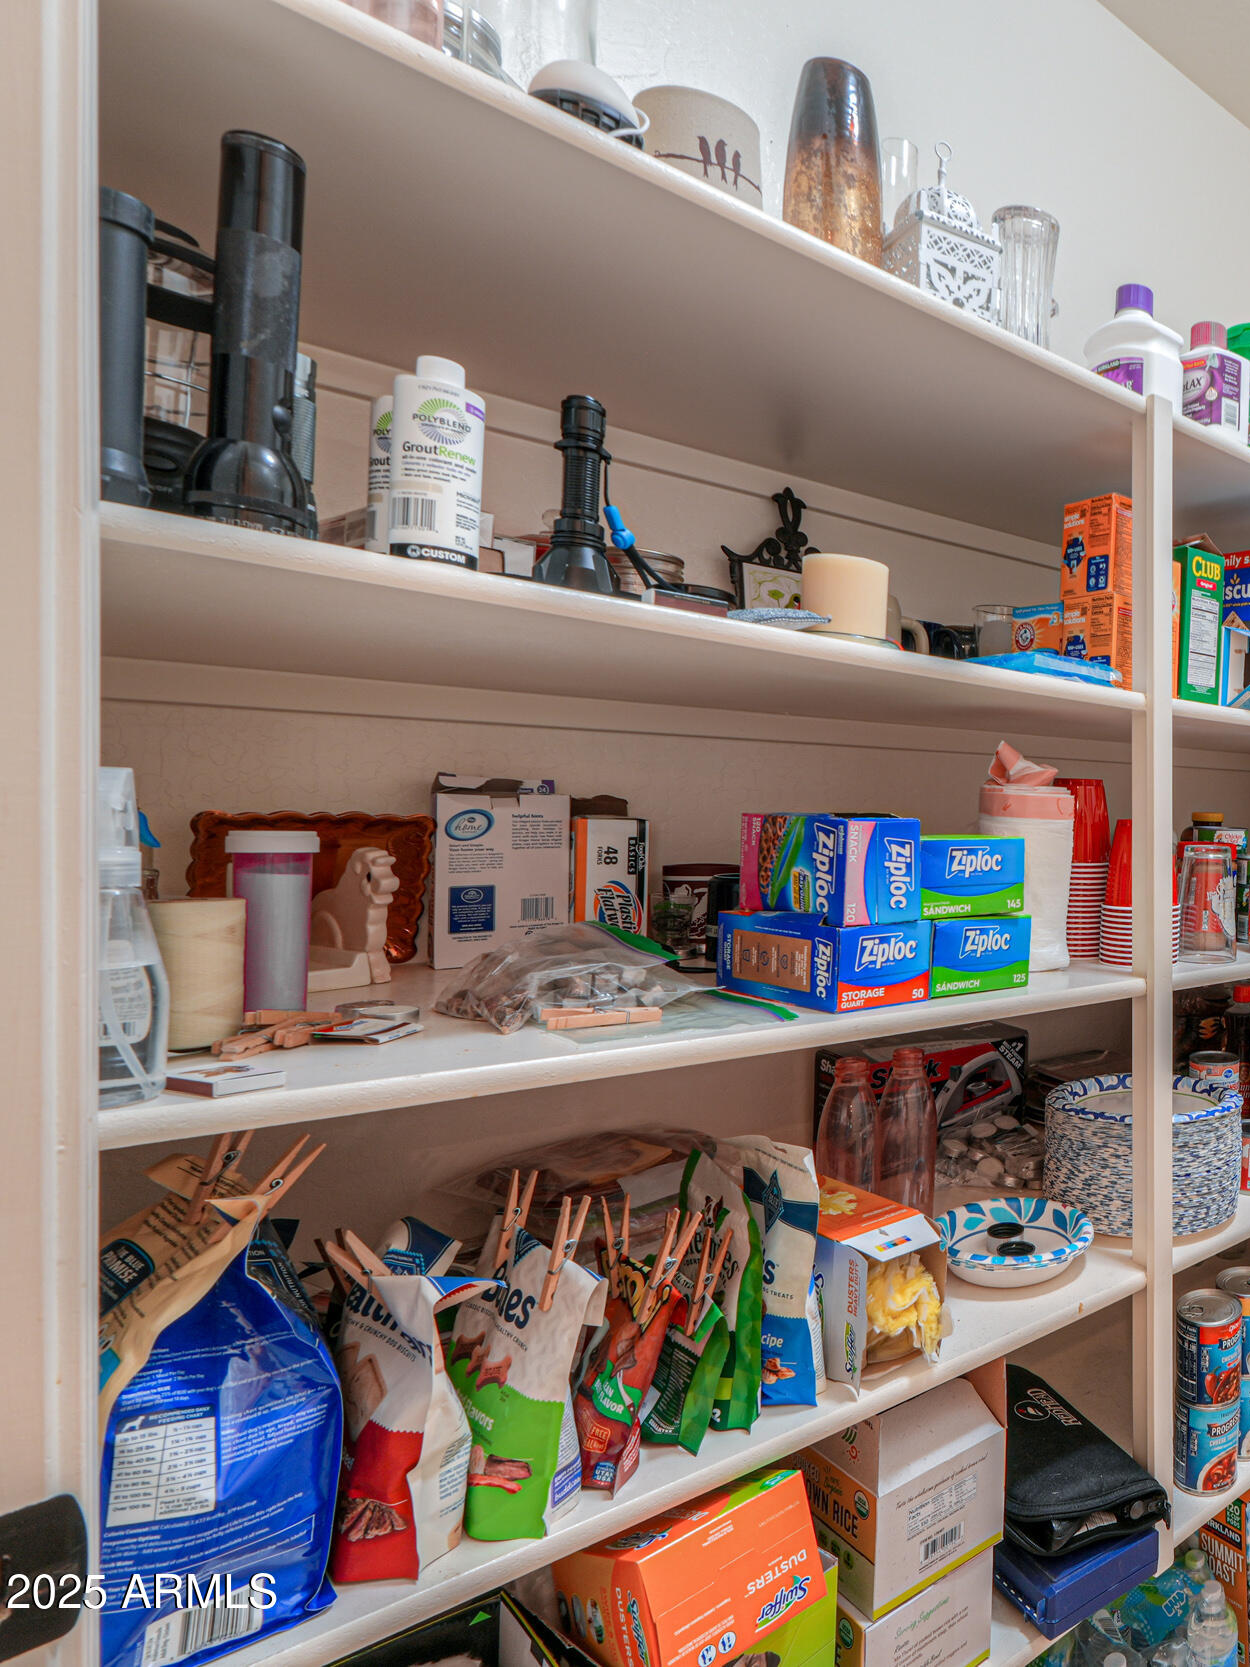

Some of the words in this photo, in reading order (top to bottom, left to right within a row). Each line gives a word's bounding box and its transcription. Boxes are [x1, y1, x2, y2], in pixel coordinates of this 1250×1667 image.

[412, 413, 471, 433] POLYBLEND
[402, 441, 476, 466] GroutRenew
[421, 548, 466, 564] CUSTOM
[1192, 556, 1221, 580] CLUB
[604, 846, 618, 866] 48
[628, 838, 636, 873] BASICS
[849, 825, 859, 863] SNACK
[812, 831, 836, 913] Ziploc
[884, 843, 911, 909] Ziploc
[951, 851, 1003, 878] Ziploc
[847, 903, 856, 923] 120
[1007, 899, 1021, 909] 145
[861, 940, 918, 969] Ziploc
[965, 930, 1011, 957] Ziploc
[814, 943, 831, 1000] Ziploc
[1013, 973, 1026, 984] 125
[841, 1000, 865, 1009] QUART
[842, 988, 885, 1001] STORAGE
[912, 988, 924, 999] 50
[820, 1058, 836, 1074] Sha
[999, 1045, 1021, 1070] STEAM
[126, 1250, 145, 1271] BLUE
[770, 1290, 795, 1301] TREATS
[847, 1259, 856, 1314] DUSTERS
[363, 1325, 387, 1344] CRUNCHY
[386, 1336, 398, 1349] DOG
[397, 1344, 417, 1362] BISCUITS
[761, 1332, 784, 1349] cipe
[806, 1481, 830, 1516] OWN
[832, 1499, 859, 1541] RICE
[1201, 1532, 1245, 1574] SUMMIT
[746, 1549, 808, 1596] DUSTERS
[757, 1575, 811, 1624] Swiffer
[629, 1597, 648, 1663] Swiffer
